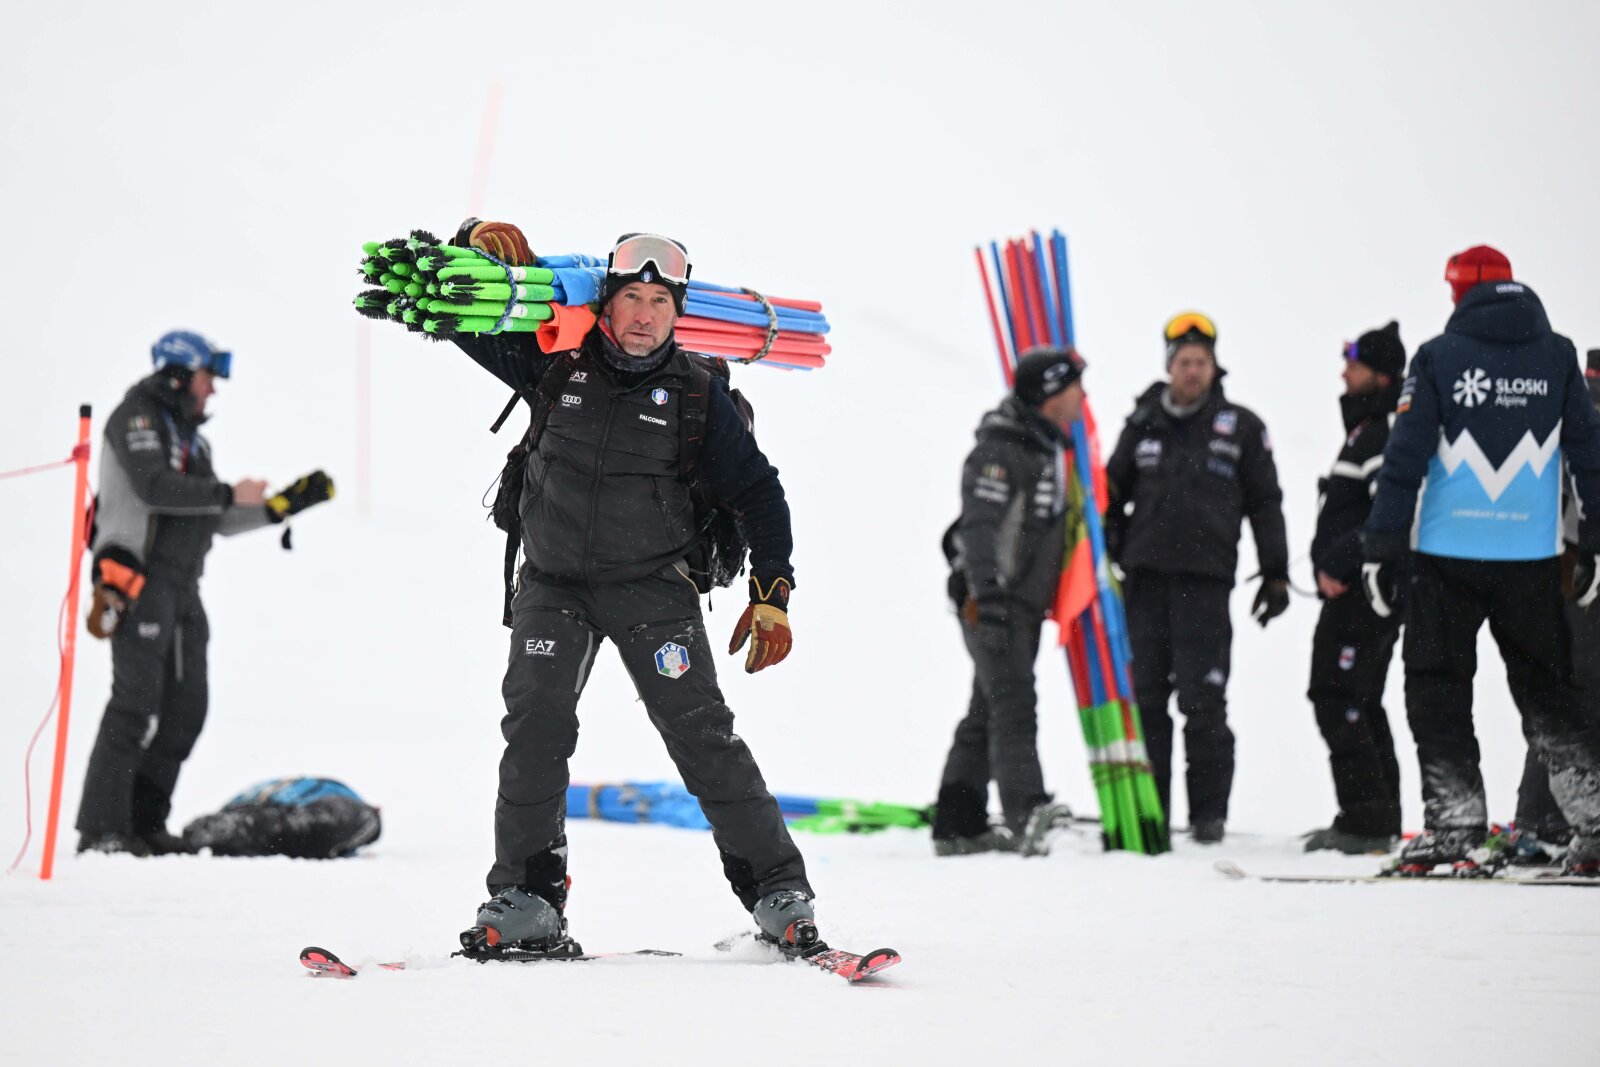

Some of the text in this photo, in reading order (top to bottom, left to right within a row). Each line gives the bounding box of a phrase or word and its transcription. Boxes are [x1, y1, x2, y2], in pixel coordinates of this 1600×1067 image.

[1495, 377, 1548, 395] SLOSKI
[639, 413, 667, 426] FALCONERI
[526, 639, 556, 652] EA7
